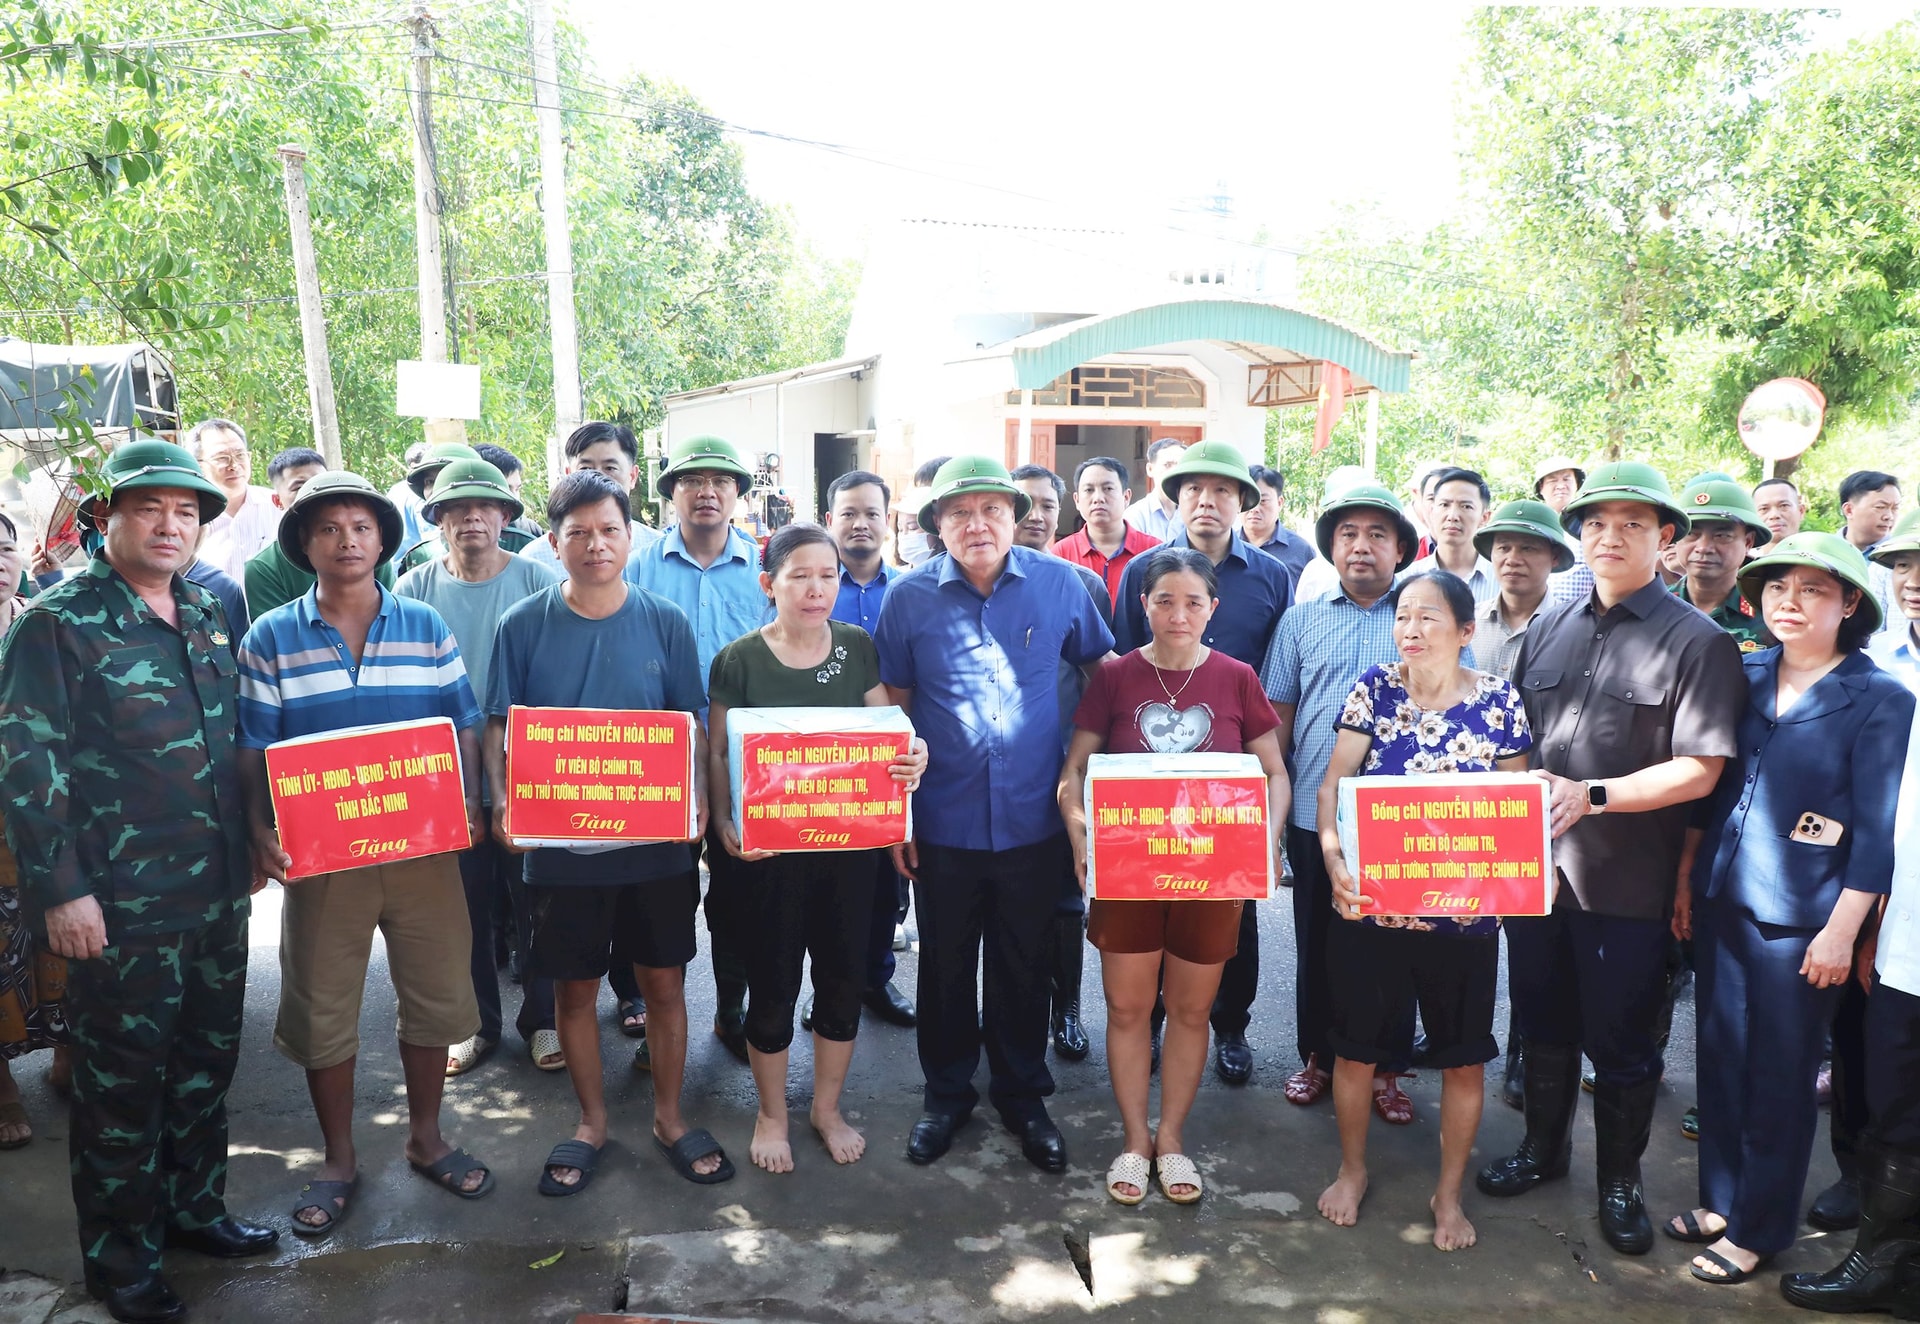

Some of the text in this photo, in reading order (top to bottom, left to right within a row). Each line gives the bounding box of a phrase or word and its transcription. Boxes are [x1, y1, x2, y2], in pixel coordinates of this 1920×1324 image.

[527, 720, 674, 744] Đồng chí NGUYỄN HÒA BÌNH
[757, 741, 896, 766] Đồng chí NGUYỄN HÒA BÌNH
[277, 772, 302, 797] TỈNH
[404, 757, 425, 778] BAN
[426, 752, 453, 774] MTTQ
[555, 754, 644, 779] ỦY VIÊN BỘ CHÍNH TRỊ,
[516, 781, 532, 799] PHÓ
[535, 779, 550, 799] THỦ
[616, 785, 636, 804] TRỰC
[639, 783, 663, 801] CHÍNH
[665, 782, 681, 802] PHỦ
[797, 776, 814, 794] VIÊN
[817, 776, 827, 797] BỘ
[829, 776, 853, 793] CHÍNH
[855, 778, 868, 795] TRỊ,
[335, 791, 408, 821] TỈNH BẮC NINH
[748, 803, 764, 819] PHÓ
[766, 800, 780, 819] THỦ
[841, 801, 860, 819] TRỰC
[862, 798, 885, 816] CHÍNH
[887, 796, 903, 815] PHỦ
[1099, 802, 1120, 826] TỈNH
[1215, 807, 1235, 824] BAN
[1237, 807, 1262, 826] MTTQ
[1371, 795, 1528, 822] Đồng chí NGUYỄN HÒA BÌNH
[570, 813, 627, 833] Tặng
[349, 838, 408, 858] Tặng
[798, 828, 851, 846] Tặng
[1147, 832, 1214, 855] TỈNH BẮC NINH
[1403, 832, 1498, 855] ỦY VIÊN BỘ CHÍNH TRỊ,
[1365, 861, 1382, 880] PHÓ
[1384, 859, 1400, 879] THỦ
[1468, 862, 1490, 882] TRỰC
[1492, 860, 1519, 878] CHÍNH
[1521, 857, 1539, 877] PHỦ
[1154, 874, 1210, 893] Tặng
[1422, 891, 1480, 911] Tặng
